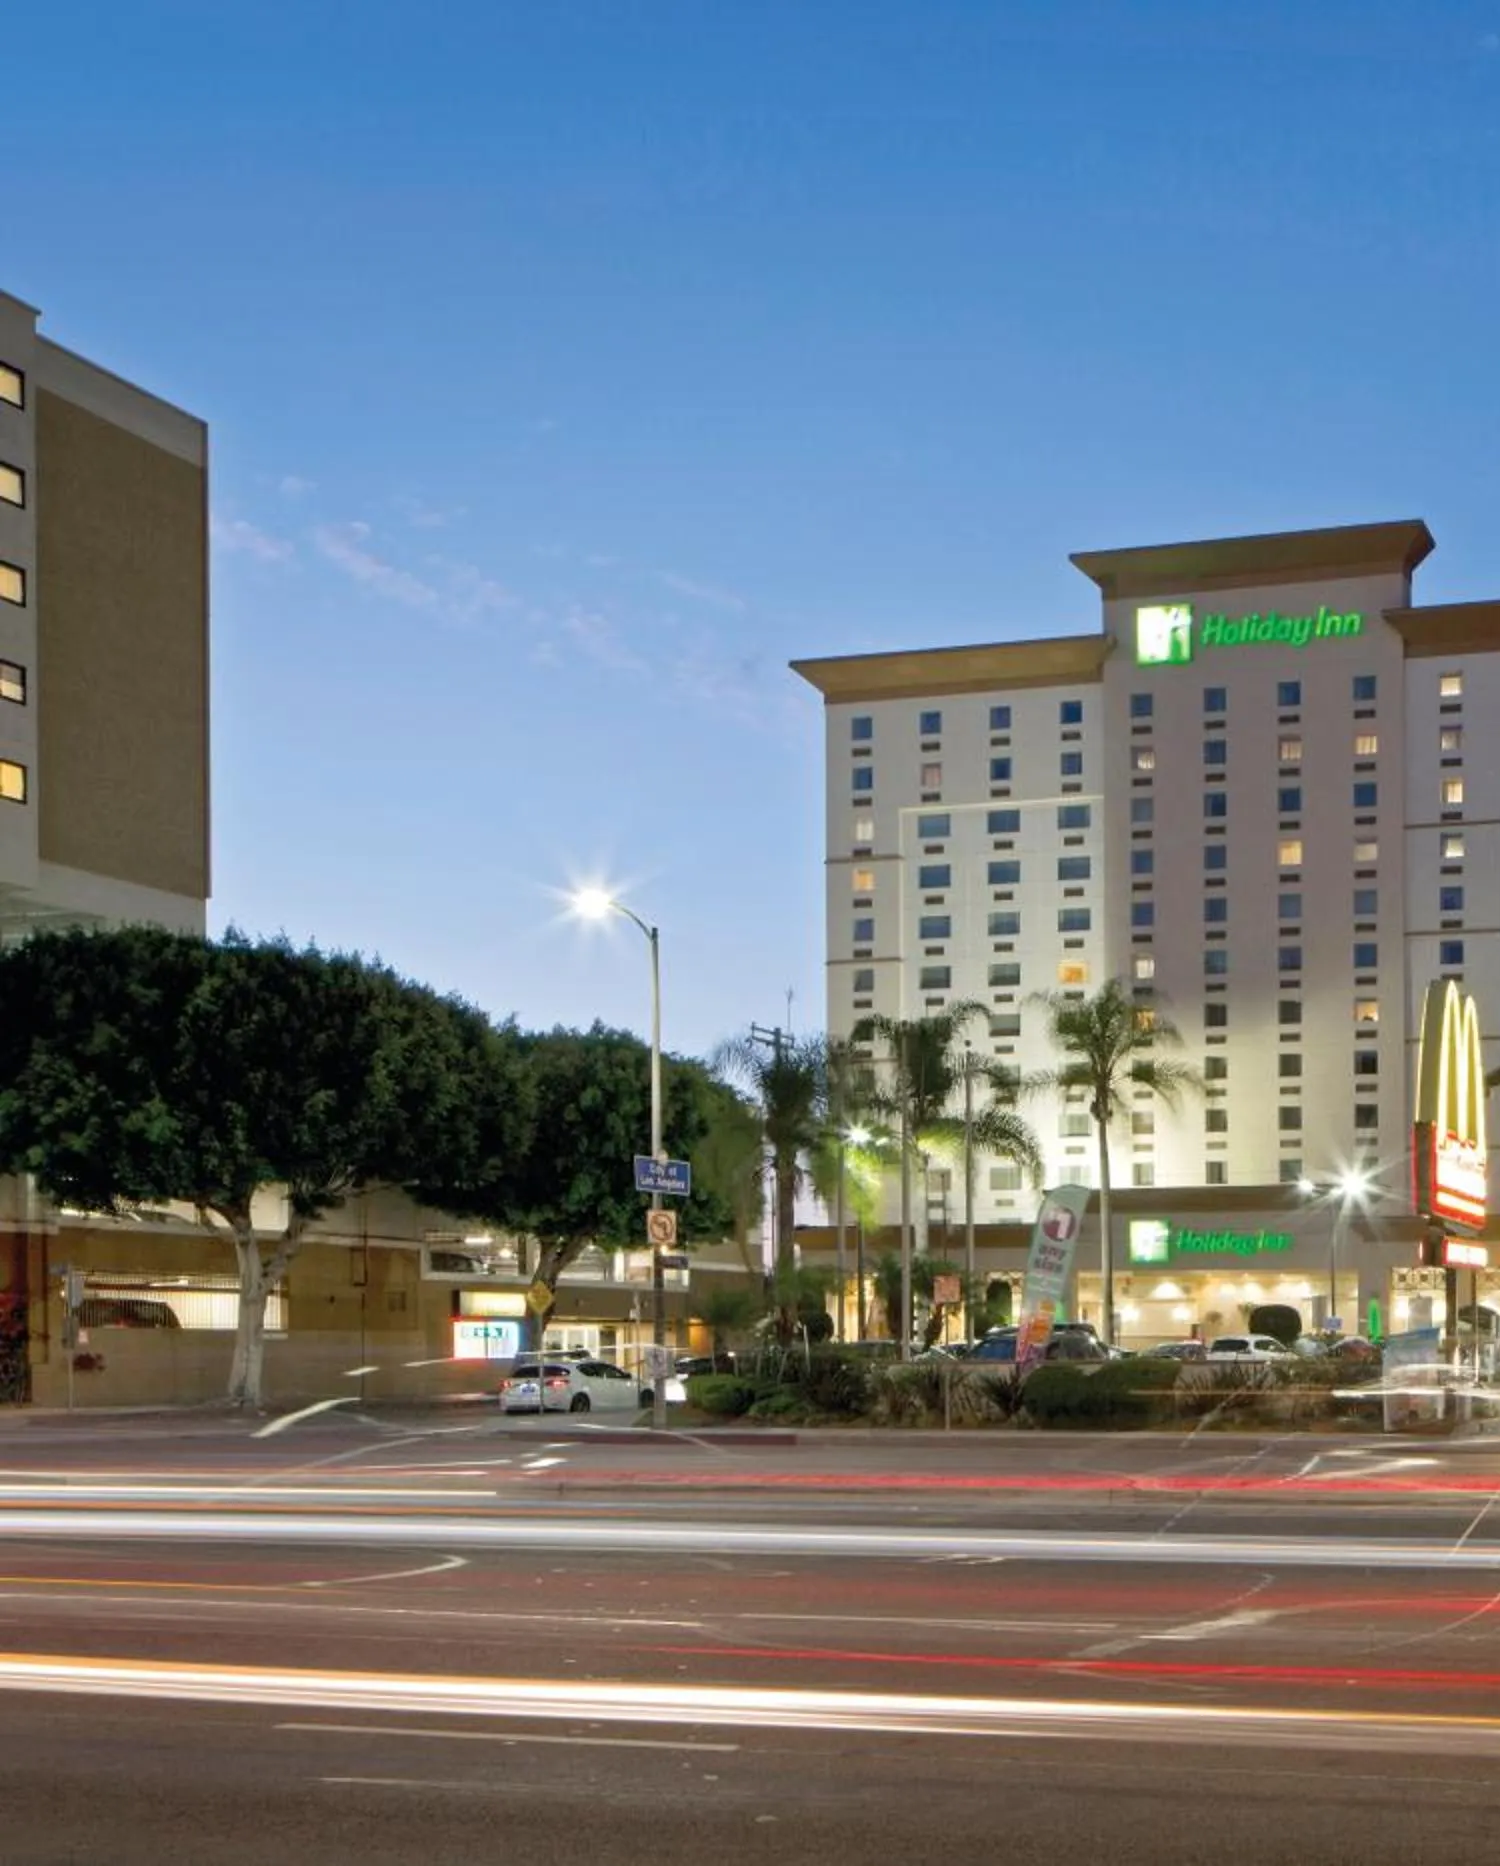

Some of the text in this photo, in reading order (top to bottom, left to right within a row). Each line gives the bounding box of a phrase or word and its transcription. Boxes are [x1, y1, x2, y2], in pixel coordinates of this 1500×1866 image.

[1201, 604, 1363, 647] Holiday Inn
[1177, 1228, 1256, 1258] Holiday
